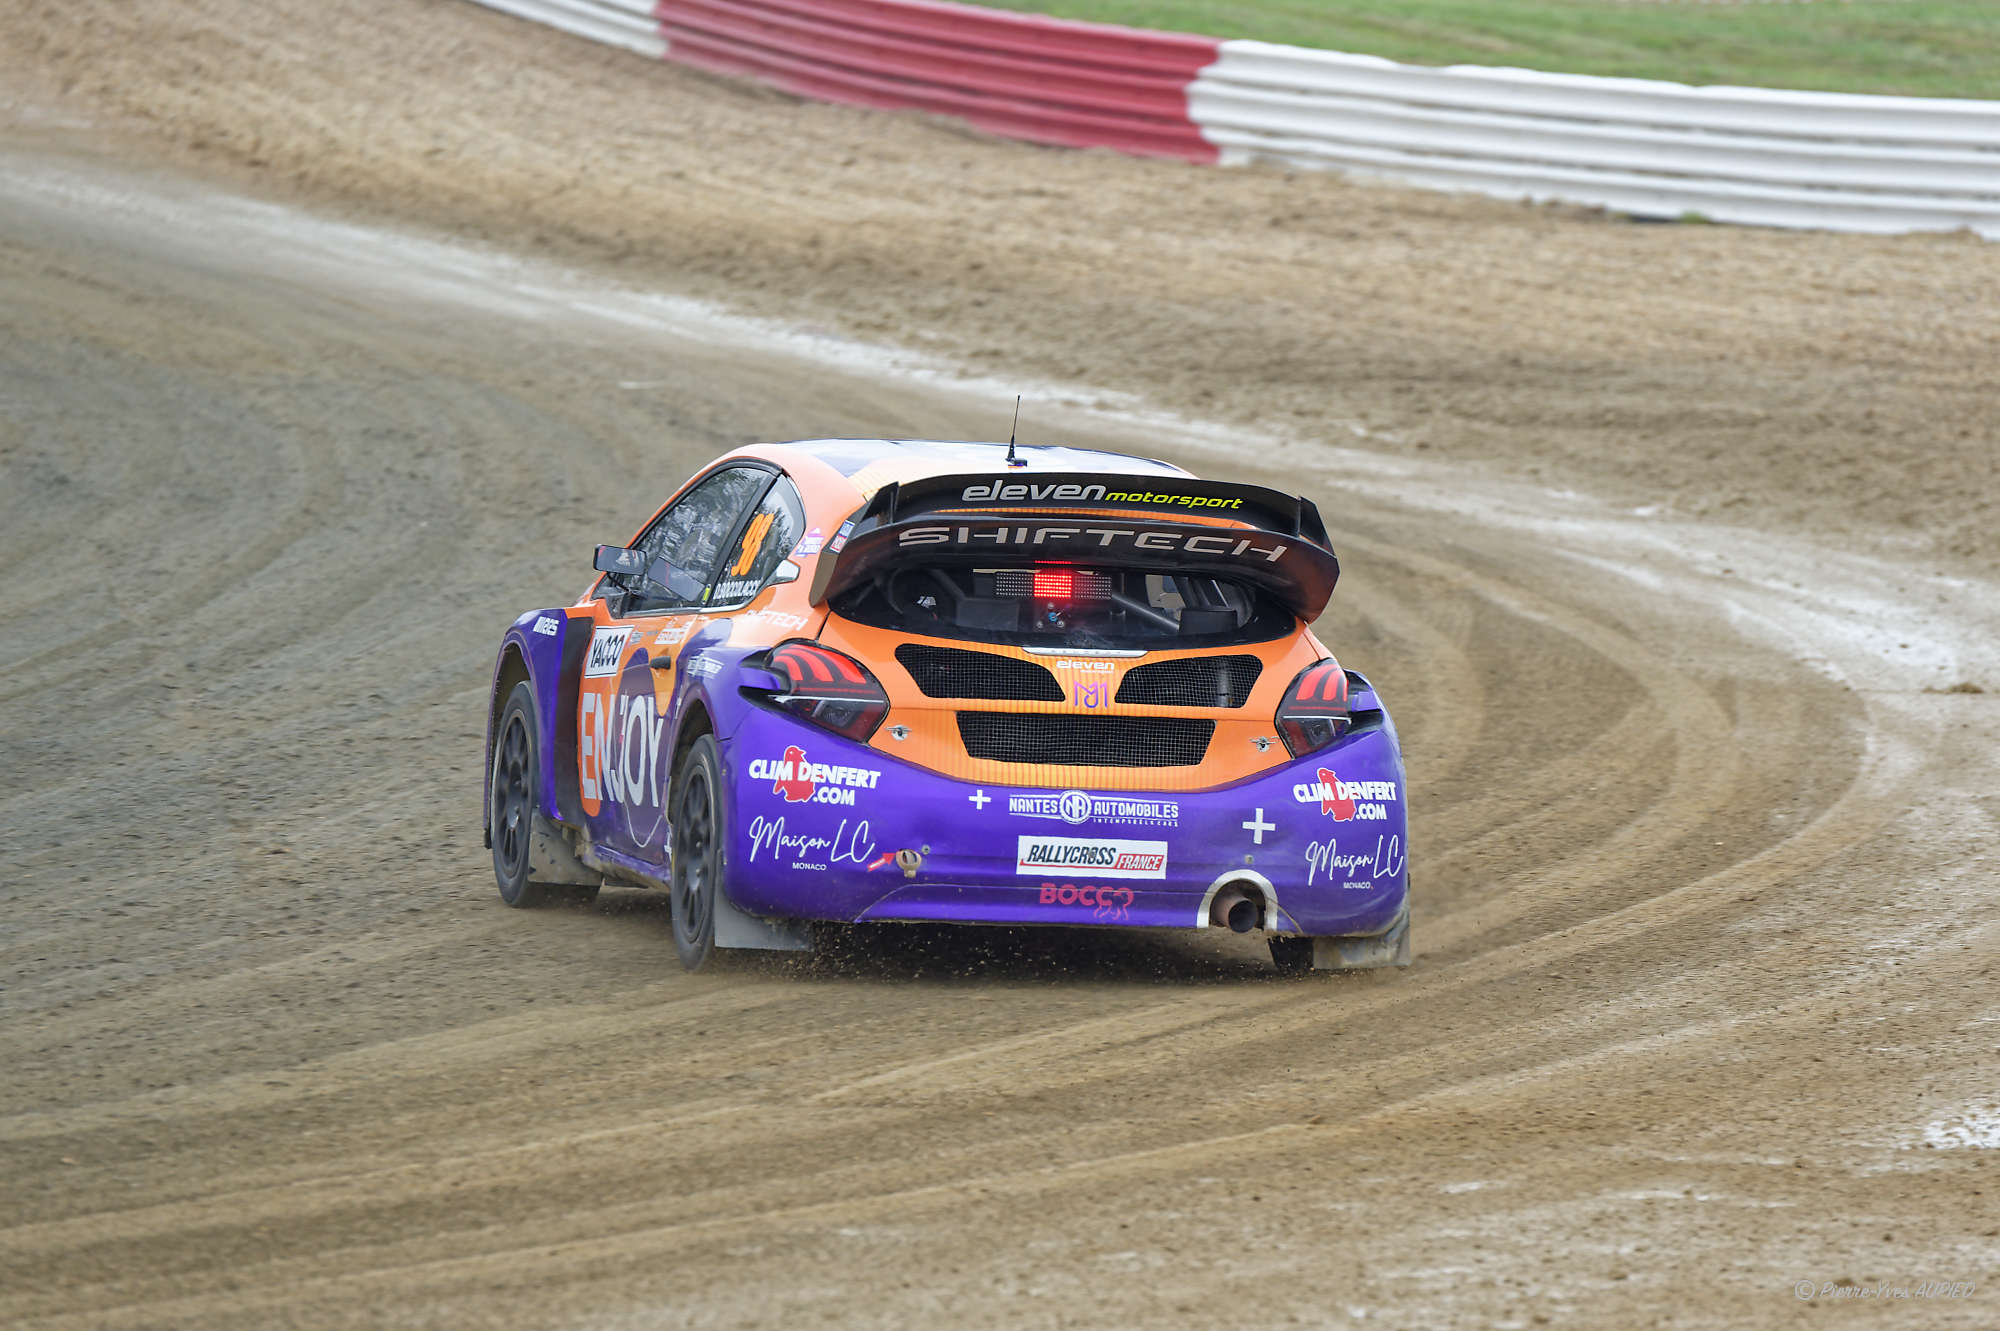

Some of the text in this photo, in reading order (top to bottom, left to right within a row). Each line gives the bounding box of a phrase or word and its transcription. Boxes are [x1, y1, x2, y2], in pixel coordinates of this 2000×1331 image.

[961, 479, 1244, 510] eleven motorsport
[899, 527, 1288, 563] SHIFTECH
[590, 631, 626, 669] YACCO
[1056, 659, 1115, 670] eleven
[581, 691, 664, 808] ENJOY
[749, 760, 793, 781] CLIM
[813, 787, 855, 805] .COM
[1293, 783, 1335, 802] CLIM
[1009, 797, 1058, 814] NANTES
[1094, 800, 1179, 819] AUTOMOBILES
[1355, 803, 1388, 820] .COM
[749, 816, 830, 862] Maison
[792, 862, 827, 871] MONACO
[1027, 844, 1163, 871] RALLYCROSS FRANCE
[1305, 838, 1373, 886] Maison
